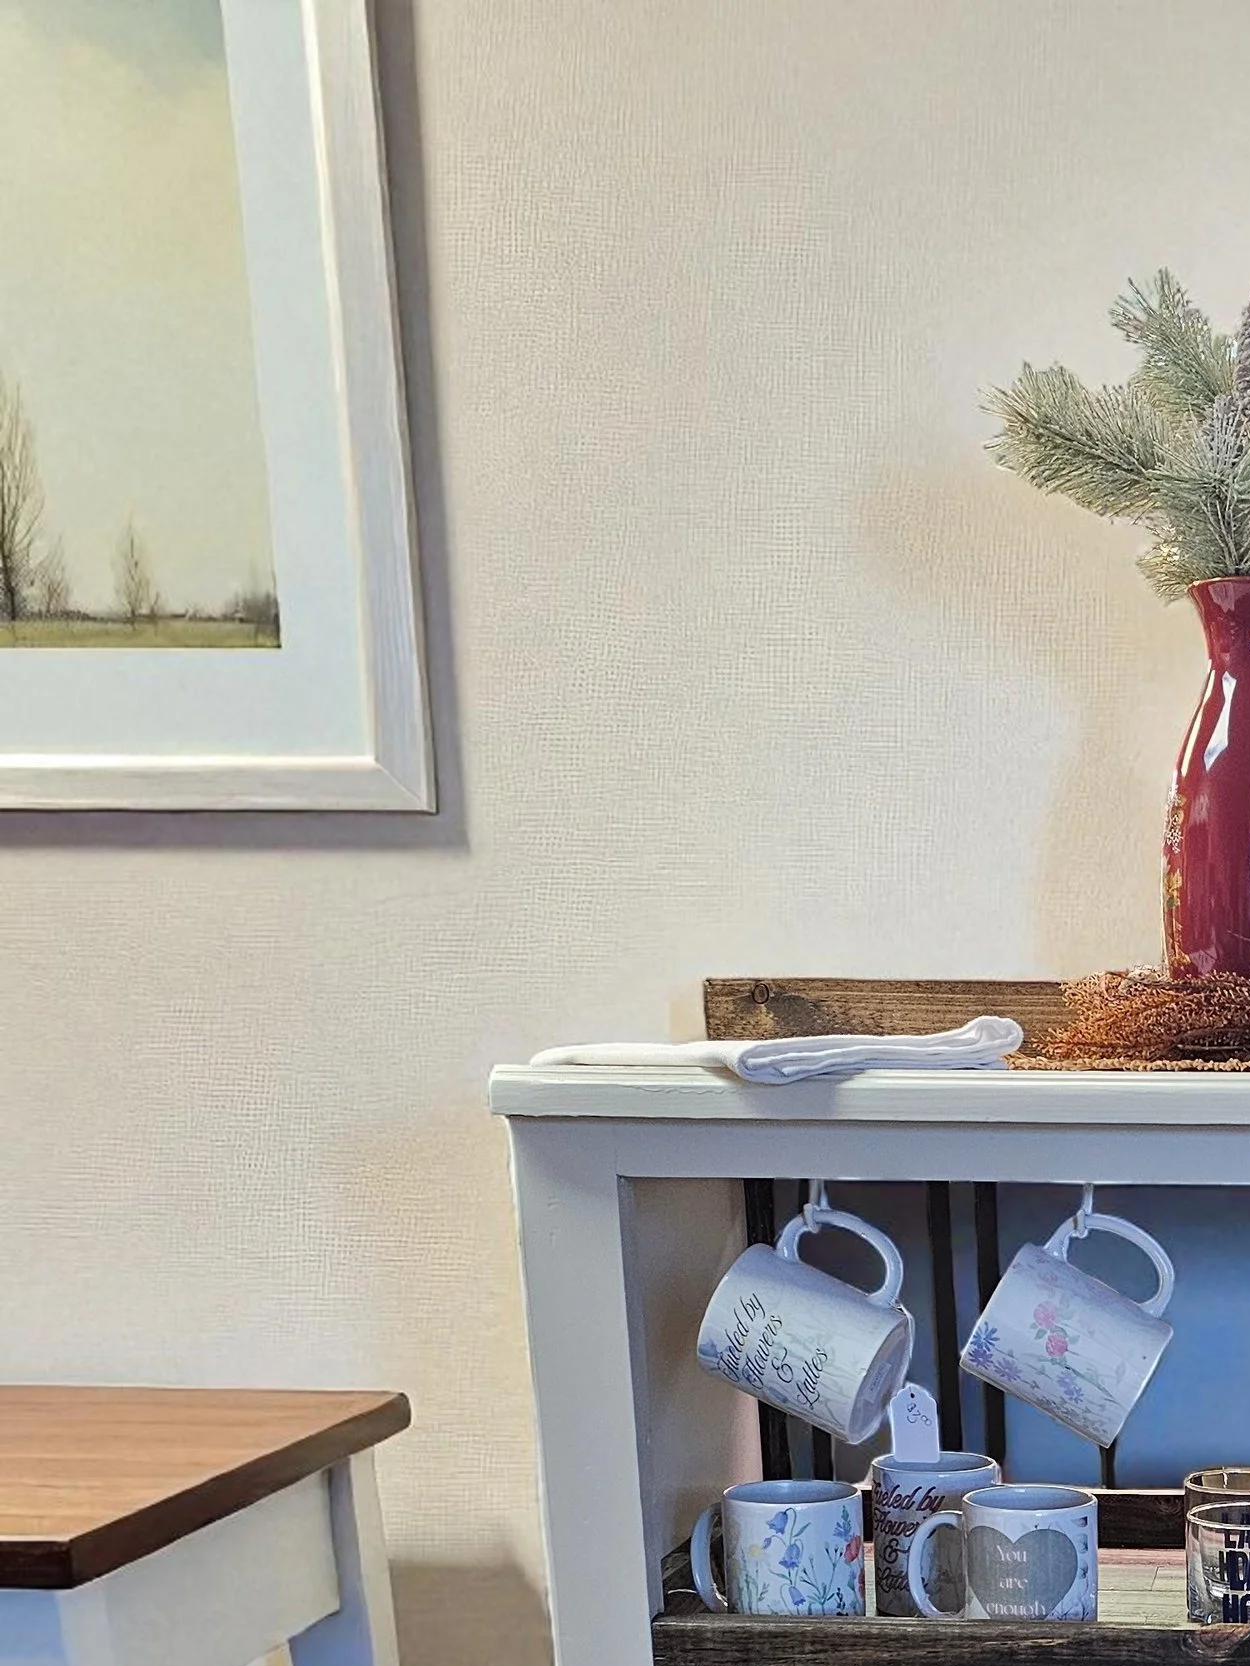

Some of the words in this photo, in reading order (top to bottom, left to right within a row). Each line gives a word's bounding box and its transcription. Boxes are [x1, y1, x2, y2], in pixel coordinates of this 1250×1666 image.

[716, 1304, 750, 1383] Fueled
[740, 1292, 766, 1323] by
[741, 1314, 783, 1391] Flowers
[771, 1346, 794, 1384] &
[793, 1347, 828, 1411] Lattes
[916, 1486, 946, 1514] by
[996, 1544, 1027, 1563] You
[999, 1577, 1028, 1590] are
[986, 1600, 1047, 1620] enough
